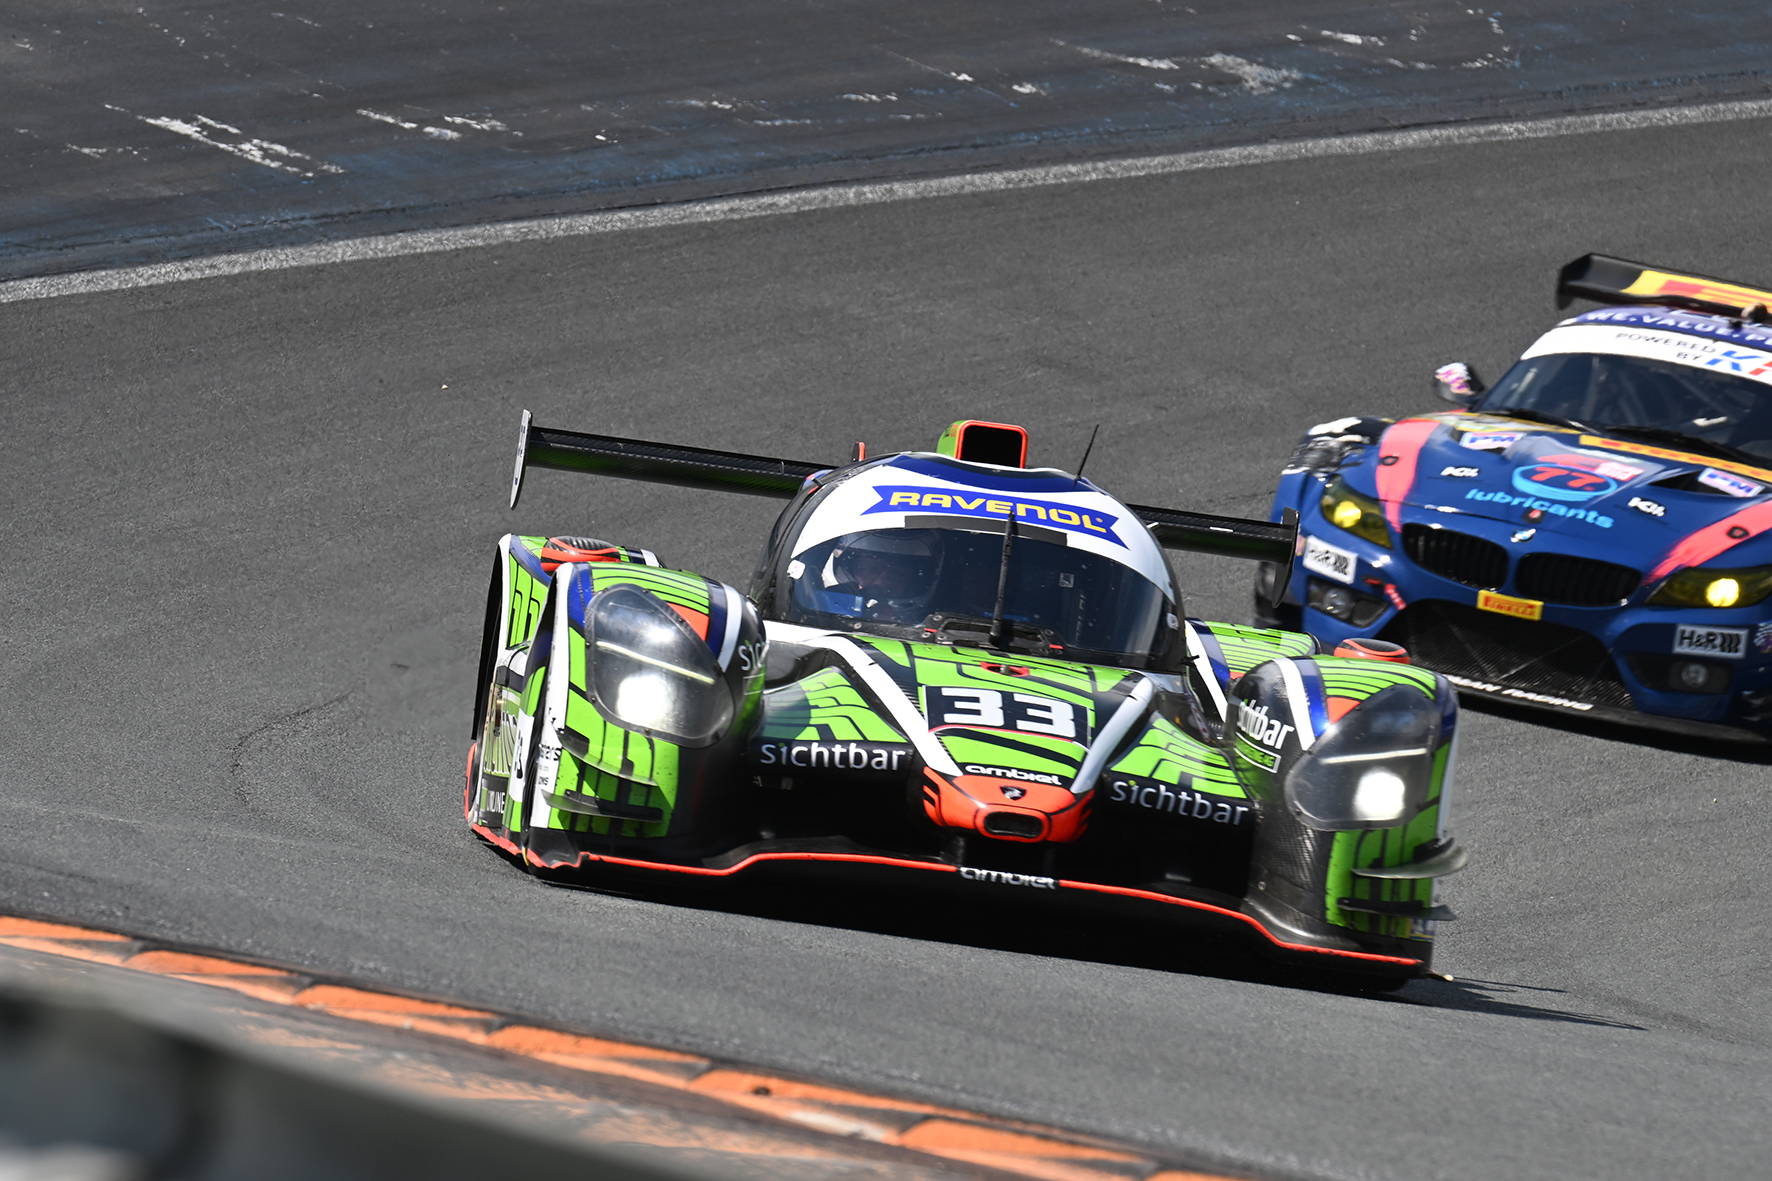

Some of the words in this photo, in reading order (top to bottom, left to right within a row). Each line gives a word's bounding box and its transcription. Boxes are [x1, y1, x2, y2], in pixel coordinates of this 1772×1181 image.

[1616, 332, 1716, 353] POWERED
[1676, 351, 1703, 361] BY
[889, 491, 1107, 533] RAVENOL
[1465, 488, 1615, 528] lubricants
[941, 687, 1076, 738] 33
[760, 742, 906, 771] sichtbar
[1110, 780, 1249, 826] sichtbar
